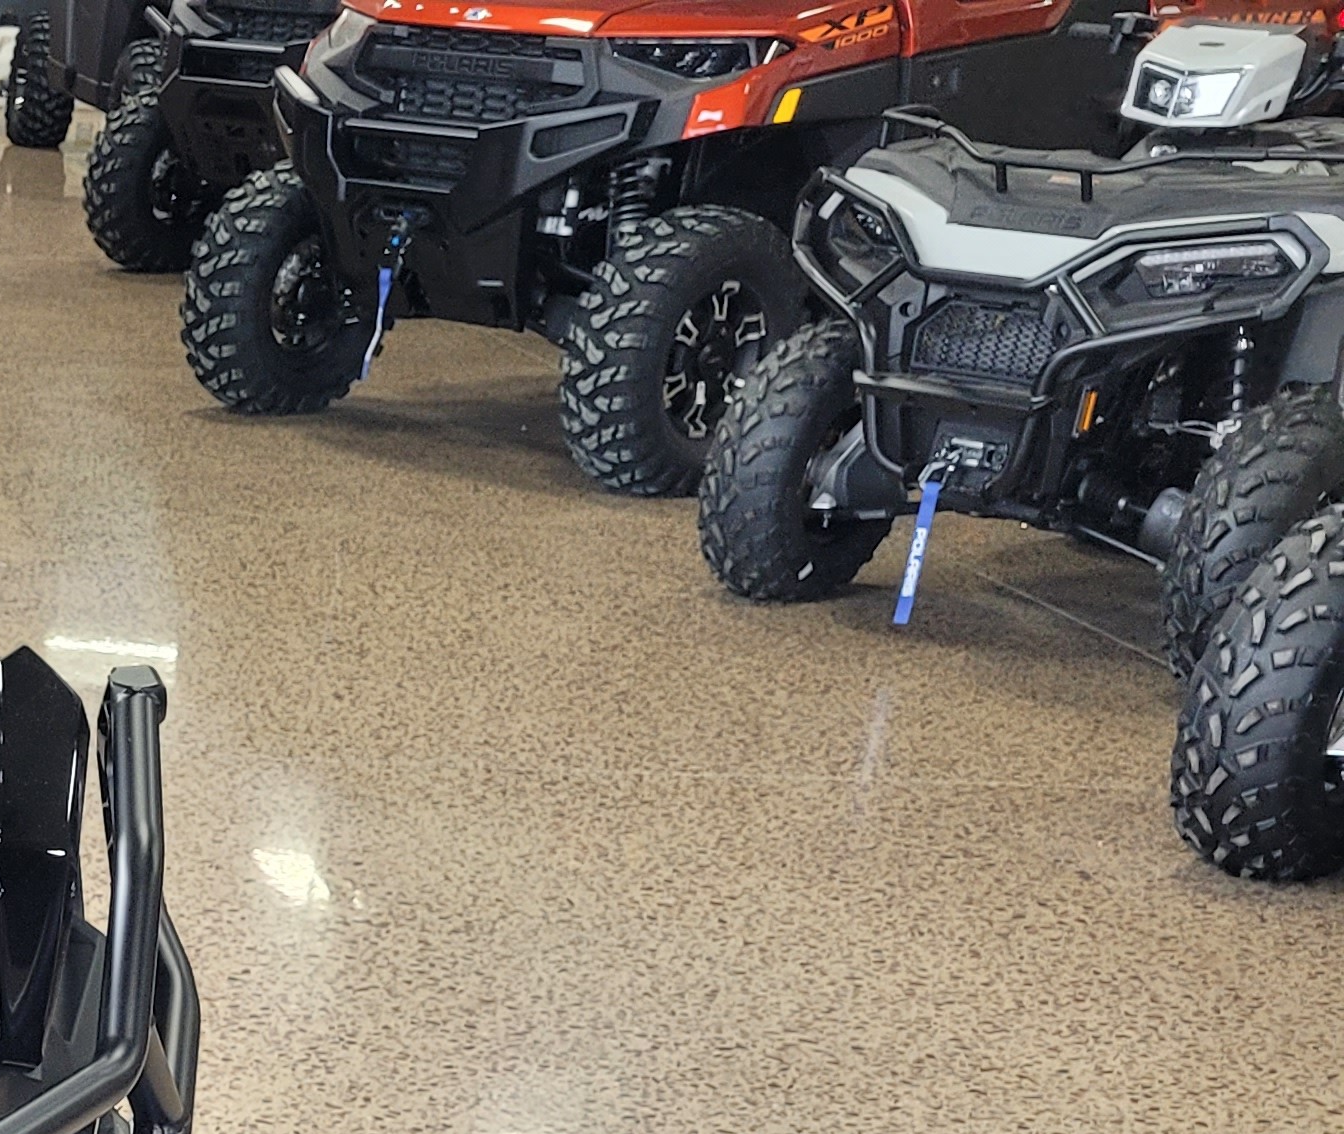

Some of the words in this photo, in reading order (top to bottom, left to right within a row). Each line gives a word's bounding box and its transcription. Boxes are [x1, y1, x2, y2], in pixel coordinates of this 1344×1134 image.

[819, 5, 892, 38] XP
[834, 24, 889, 49] 1000
[413, 51, 514, 78] POLARIS
